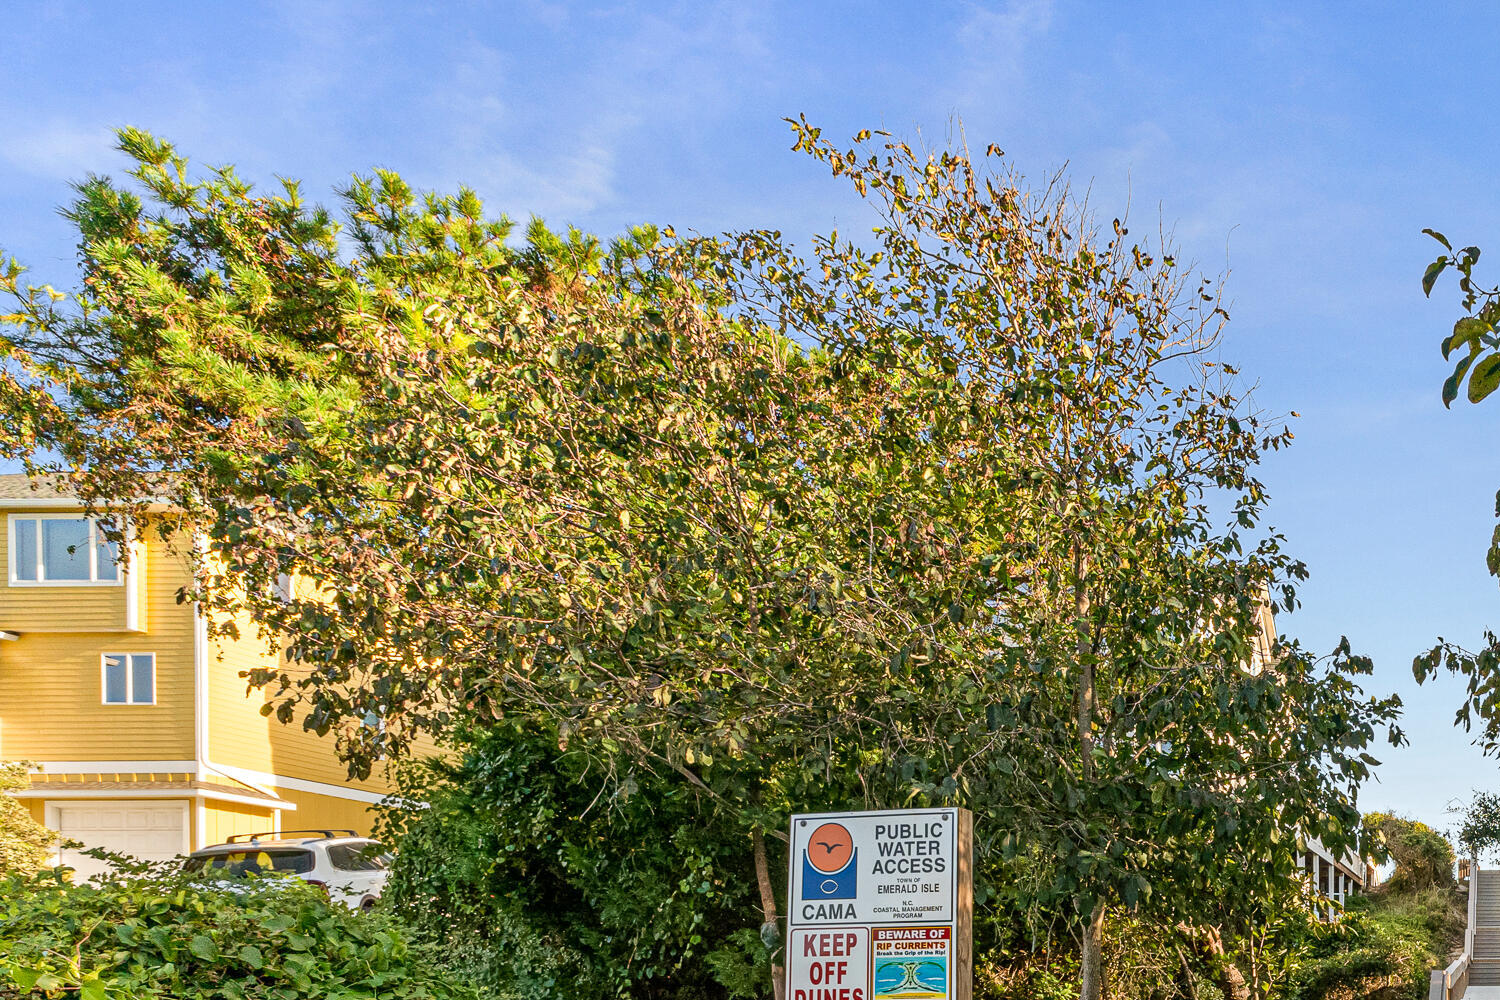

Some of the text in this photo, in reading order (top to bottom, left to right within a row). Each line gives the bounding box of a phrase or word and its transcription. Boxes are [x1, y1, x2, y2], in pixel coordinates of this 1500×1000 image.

[875, 823, 943, 840] PUBLIC
[878, 841, 940, 857] WATER
[872, 858, 946, 875] ACCESS
[877, 883, 940, 894] EMERALD ISLE
[802, 903, 857, 920] CAMA
[878, 929, 945, 940] BEWARE OF
[803, 933, 858, 957] KEEP
[876, 941, 946, 950] RIP CURRENTS
[809, 961, 848, 986] OFF
